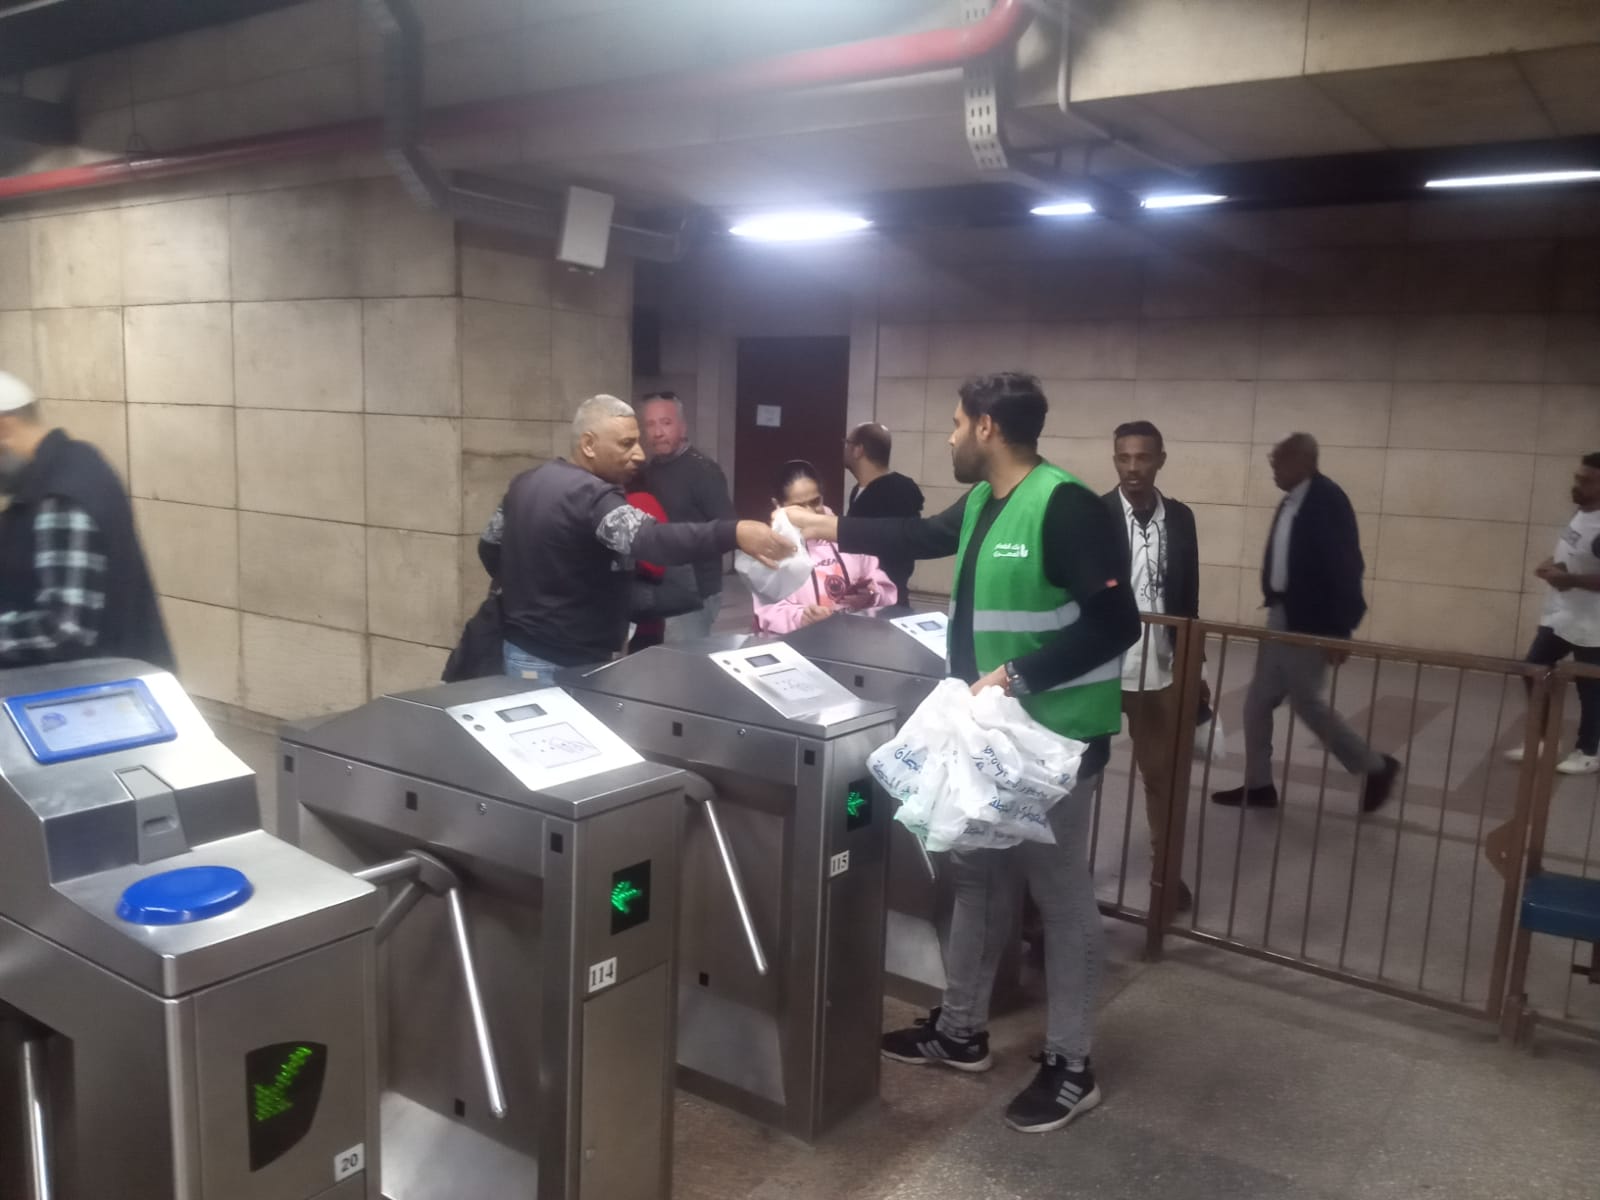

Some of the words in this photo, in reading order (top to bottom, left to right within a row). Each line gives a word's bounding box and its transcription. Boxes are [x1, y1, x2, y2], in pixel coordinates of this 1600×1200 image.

[832, 853, 848, 873] 115
[591, 961, 614, 987] 114
[341, 1153, 359, 1173] 20
